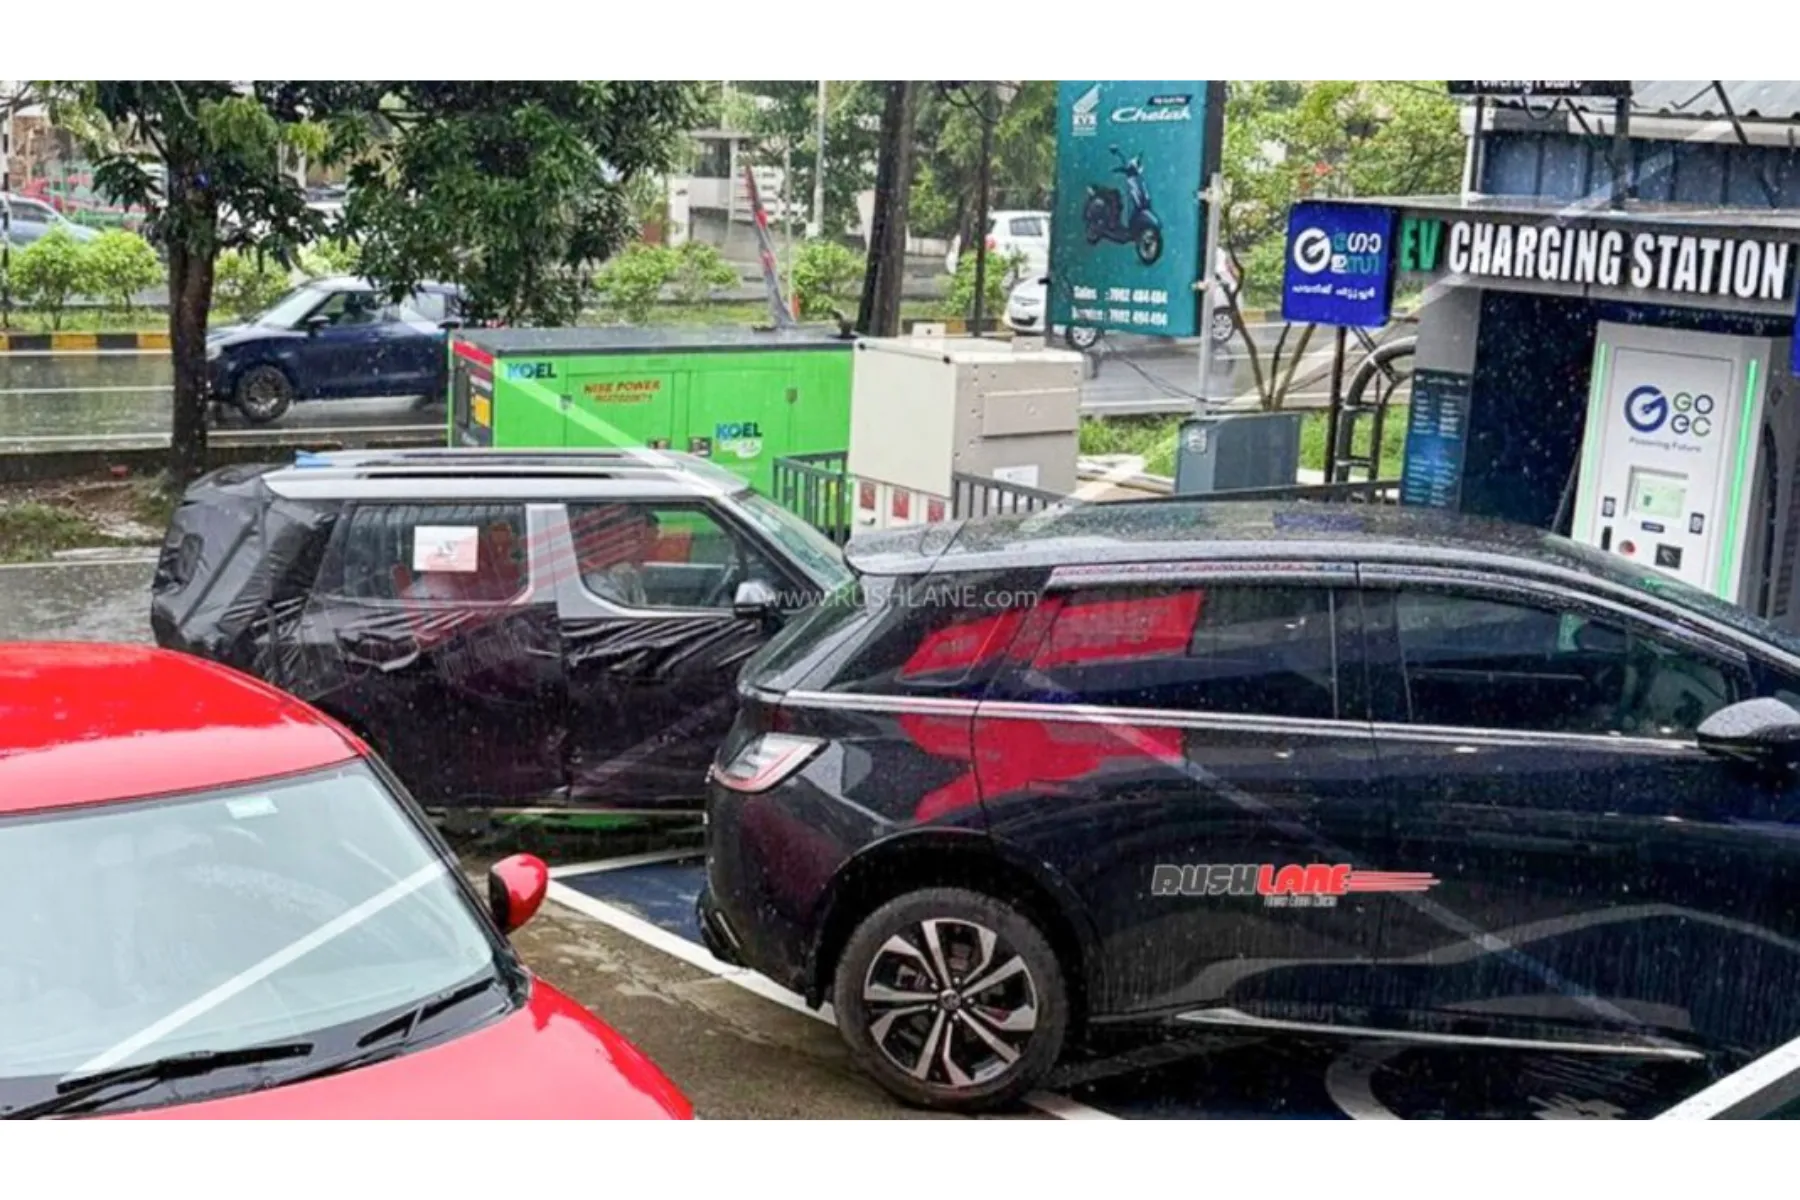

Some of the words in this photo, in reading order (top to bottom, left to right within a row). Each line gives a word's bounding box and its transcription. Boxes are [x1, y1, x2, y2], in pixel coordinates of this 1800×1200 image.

[1402, 218, 1441, 272] EV
[1448, 219, 1623, 286] CHARGING
[1630, 231, 1789, 299] STATION
[507, 362, 557, 380] KOEL
[1673, 391, 1714, 415] GO
[715, 421, 763, 440] KOEL
